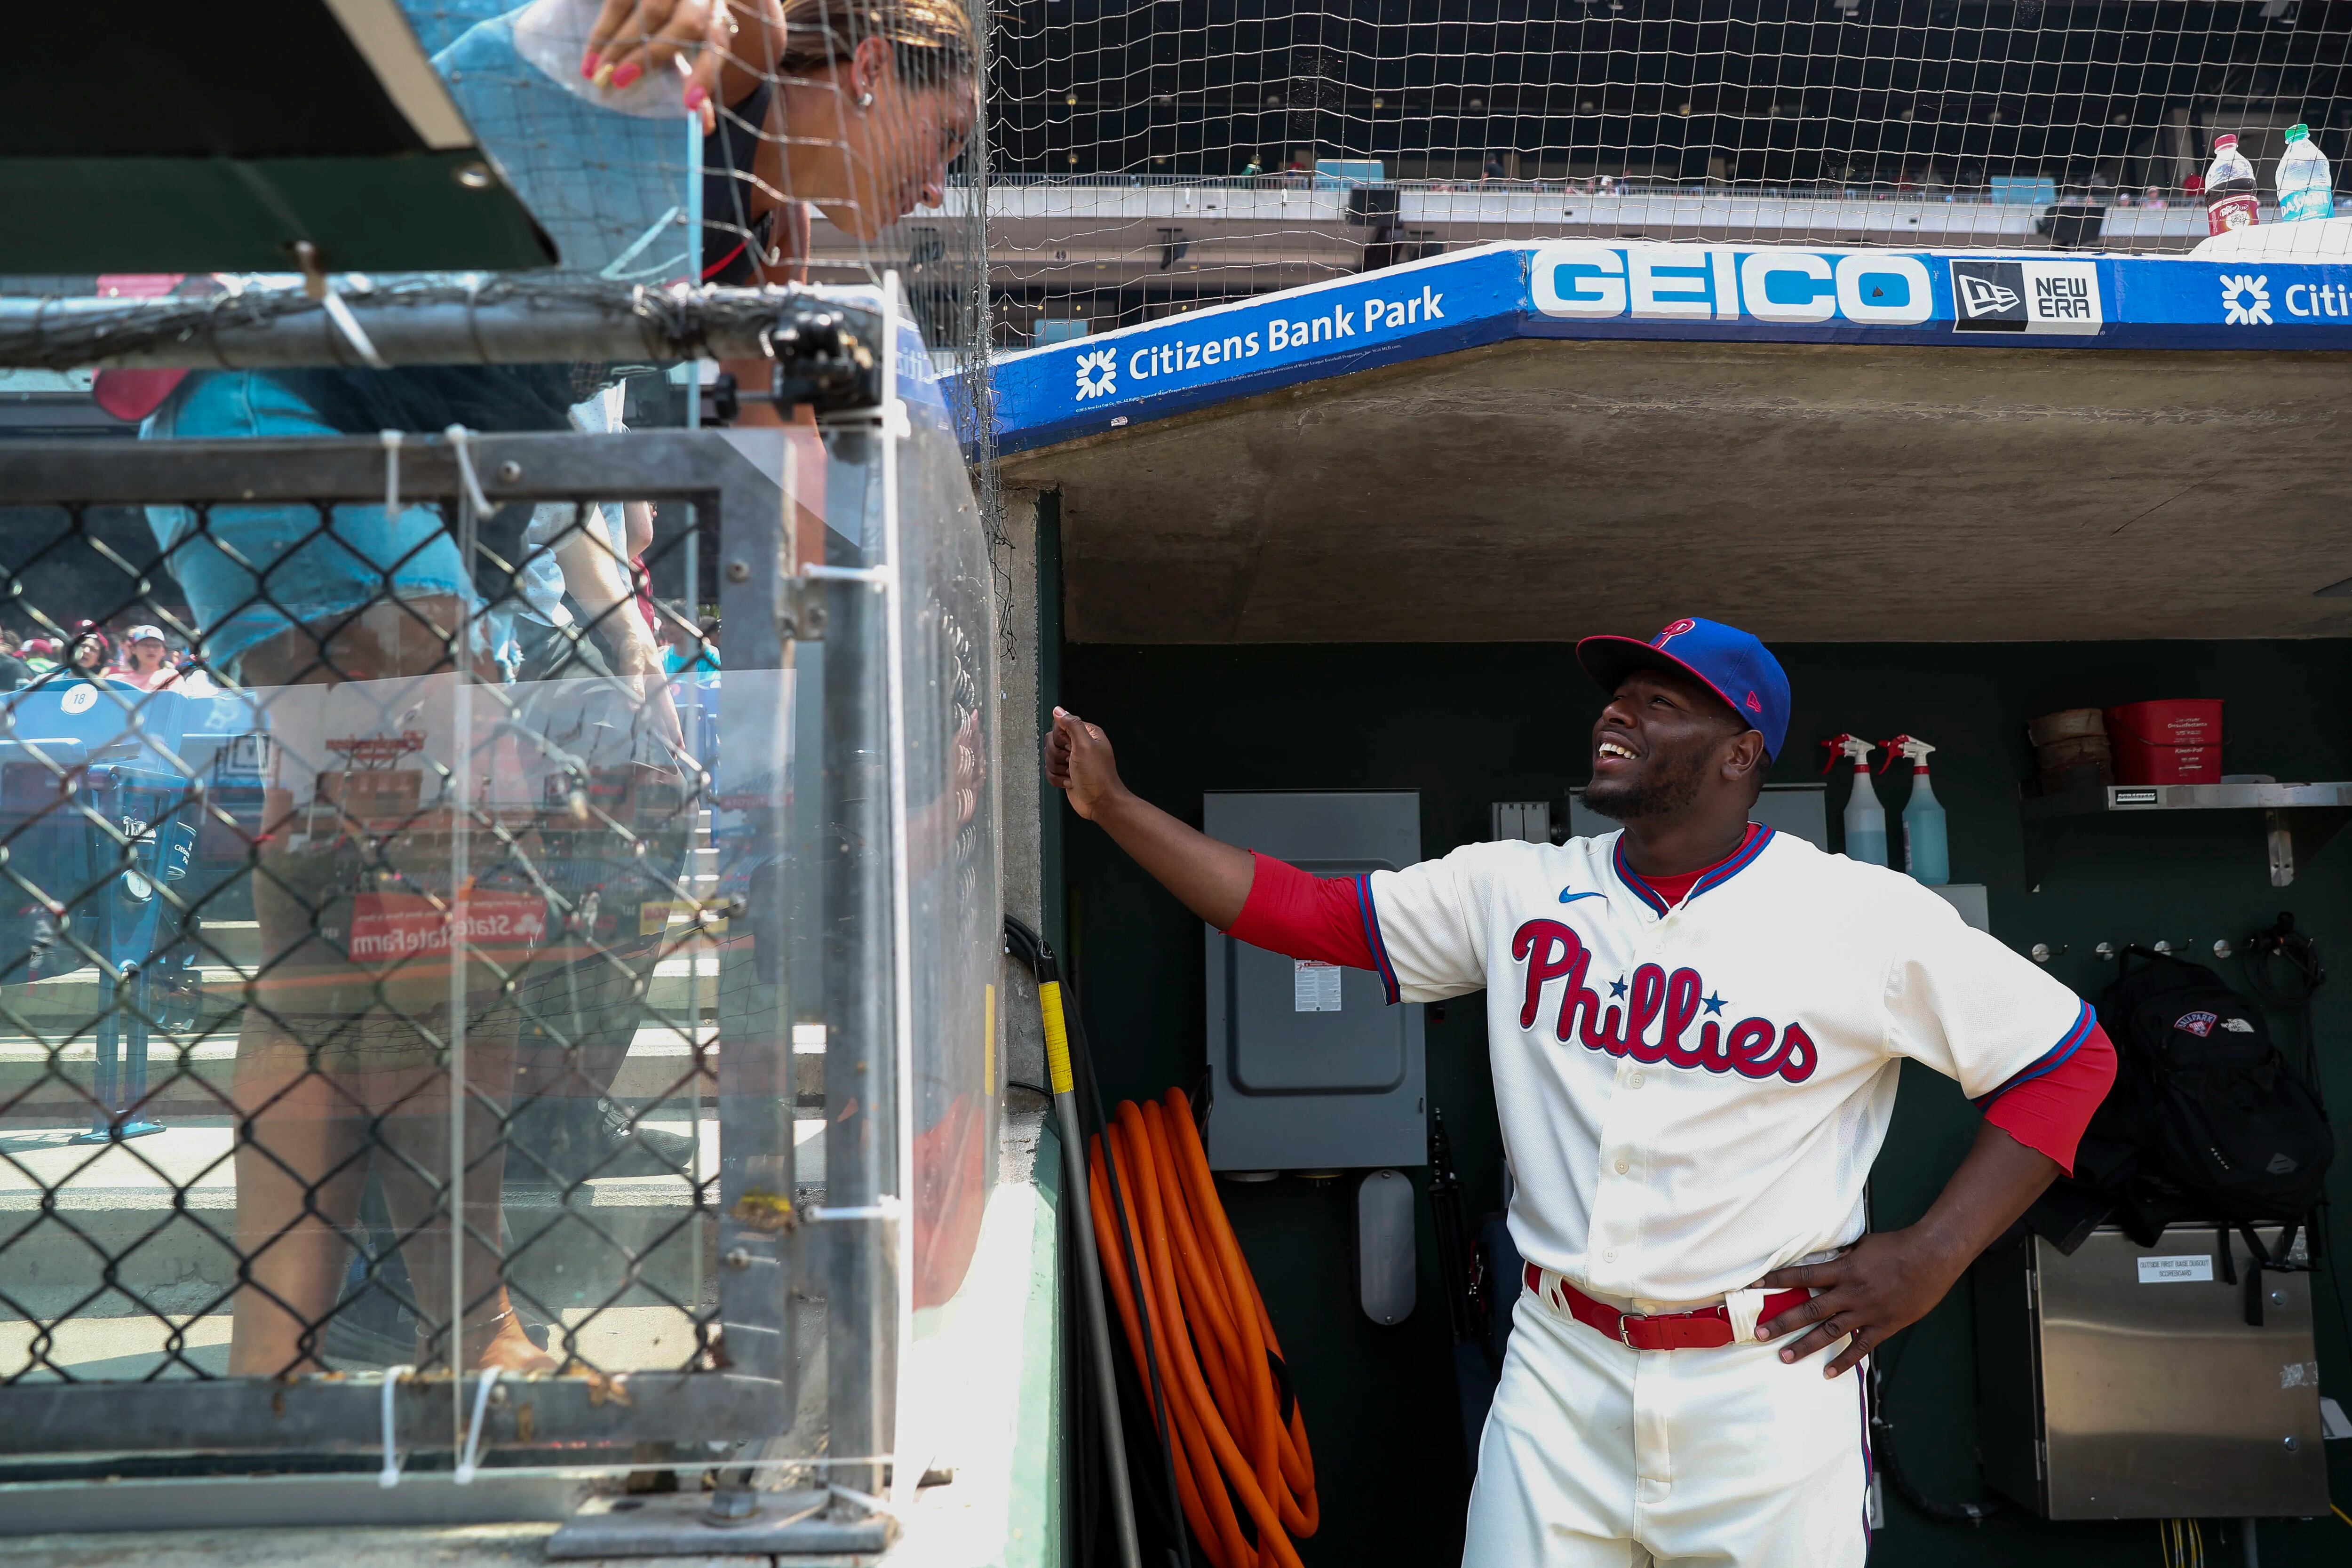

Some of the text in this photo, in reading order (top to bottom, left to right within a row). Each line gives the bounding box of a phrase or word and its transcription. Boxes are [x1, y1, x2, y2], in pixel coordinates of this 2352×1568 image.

[1531, 248, 1933, 325] GEICO
[2035, 278, 2087, 297] NEW
[2285, 284, 2352, 317] Citi
[2038, 298, 2090, 318] ERA
[1129, 285, 1445, 380] Citizens Bank Park
[1652, 618, 1695, 649] P
[73, 693, 86, 704] 18
[1512, 917, 1819, 1085] Phillies
